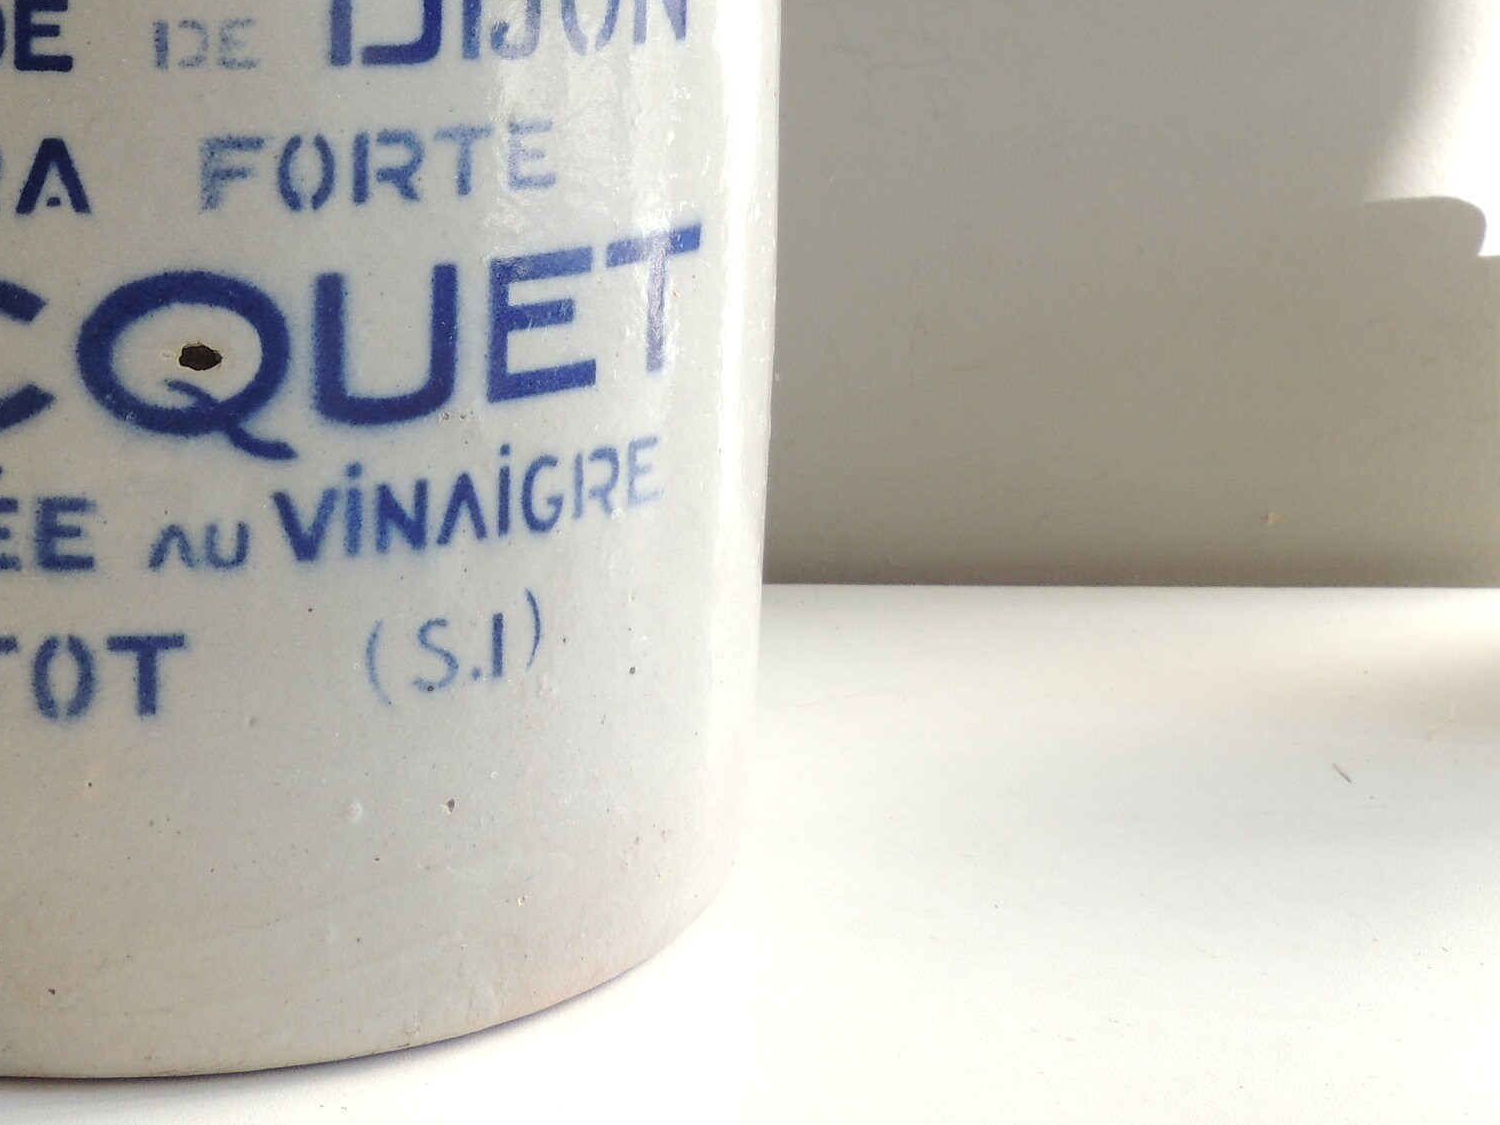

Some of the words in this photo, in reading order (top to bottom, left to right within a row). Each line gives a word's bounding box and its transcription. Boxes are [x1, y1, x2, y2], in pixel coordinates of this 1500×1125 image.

[152, 18, 262, 70] DE
[201, 118, 558, 213] FORTE
[148, 522, 250, 571] AU
